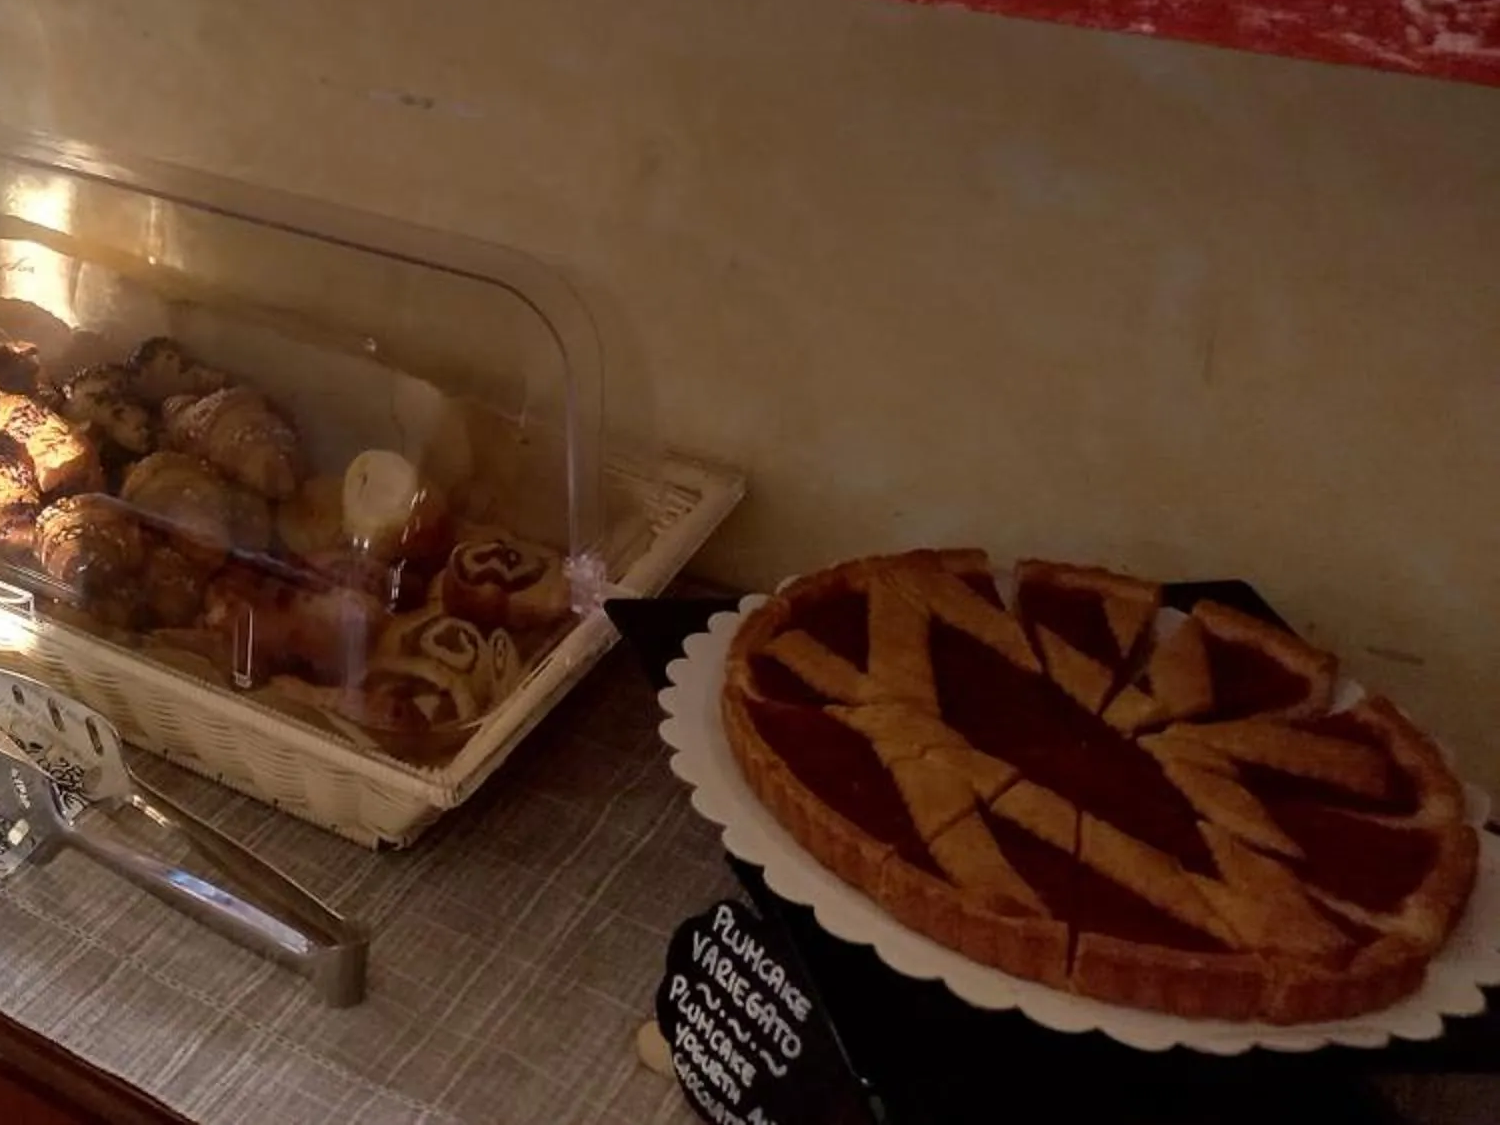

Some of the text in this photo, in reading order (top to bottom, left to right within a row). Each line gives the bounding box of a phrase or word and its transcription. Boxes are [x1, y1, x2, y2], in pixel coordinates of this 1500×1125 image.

[692, 930, 802, 1058] VARIEGATO
[713, 904, 812, 1021] PLUMCAKE
[669, 974, 757, 1088] PLUMCAKE
